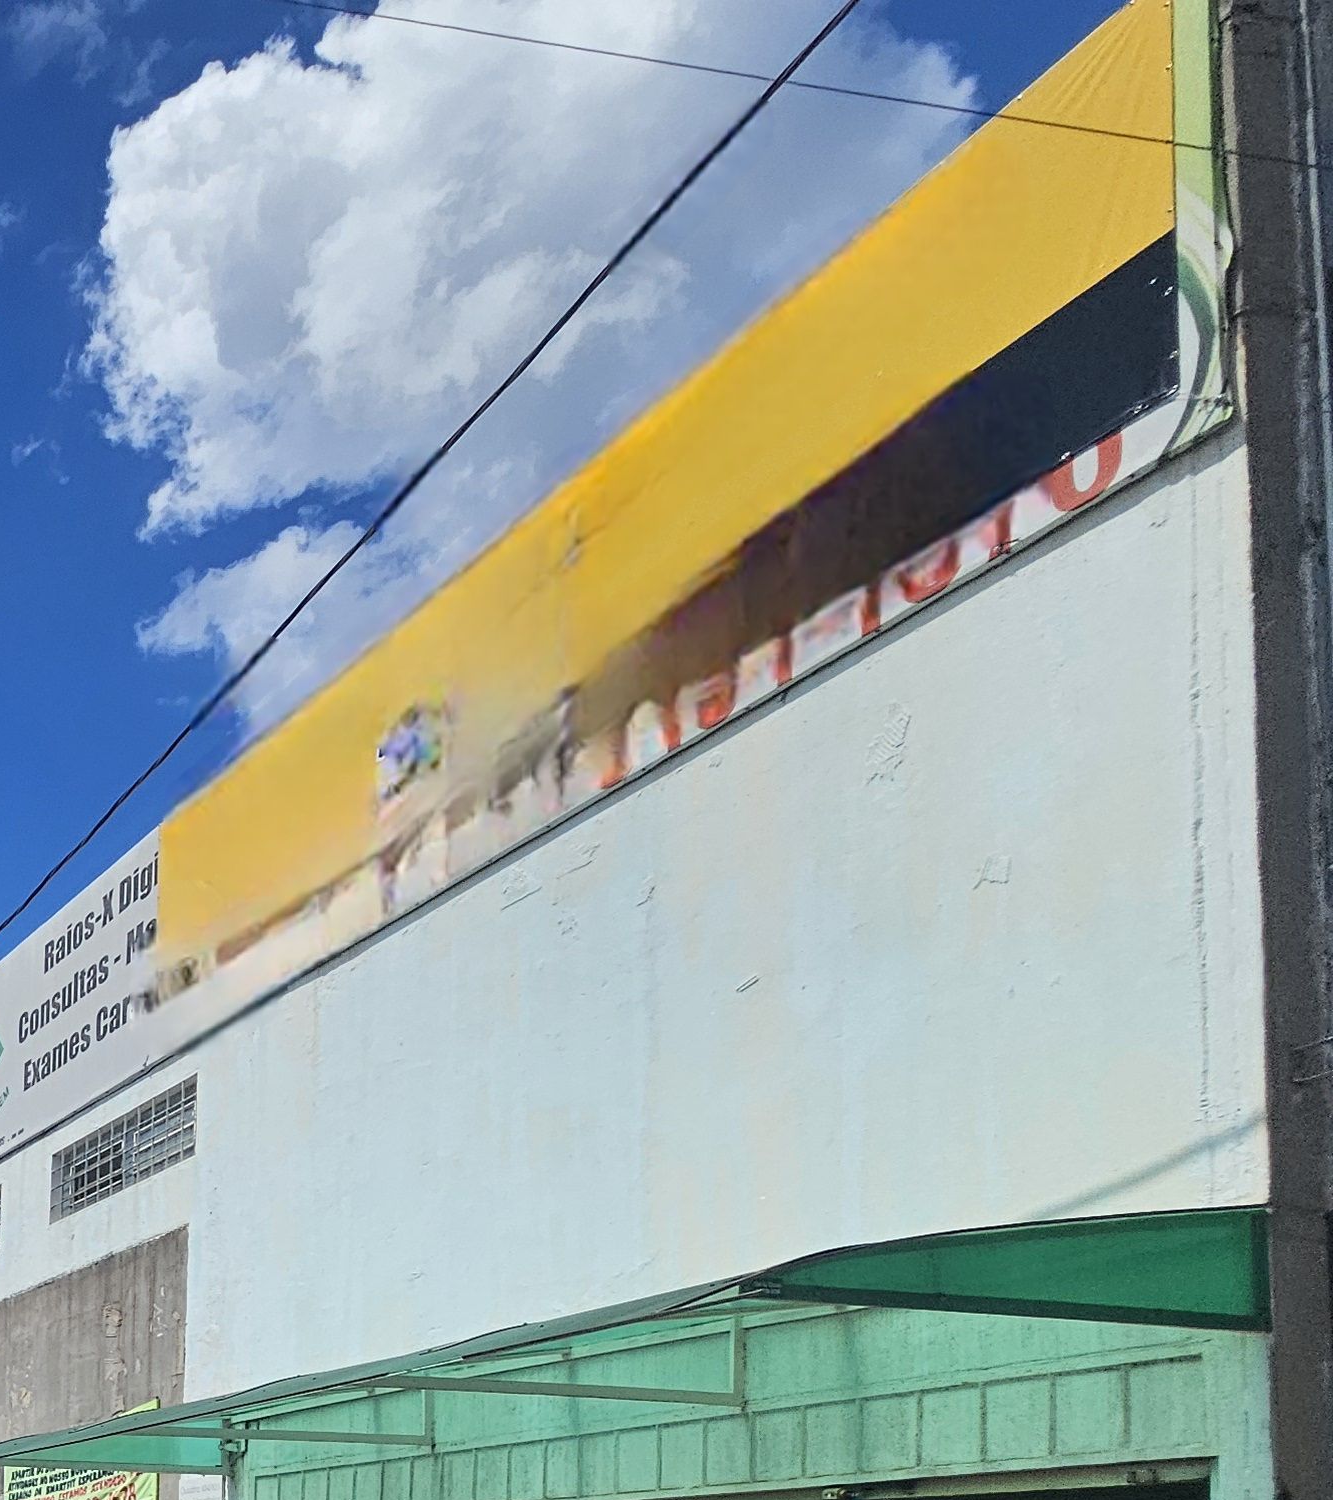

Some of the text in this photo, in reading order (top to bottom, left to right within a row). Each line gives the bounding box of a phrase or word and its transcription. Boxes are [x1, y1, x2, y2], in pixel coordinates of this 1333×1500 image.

[43, 888, 115, 975] Raios-X
[18, 954, 110, 1044] Consultas
[23, 1023, 91, 1092] Exames
[40, 1475, 48, 1486] NO
[49, 1470, 69, 1484] NOSSO
